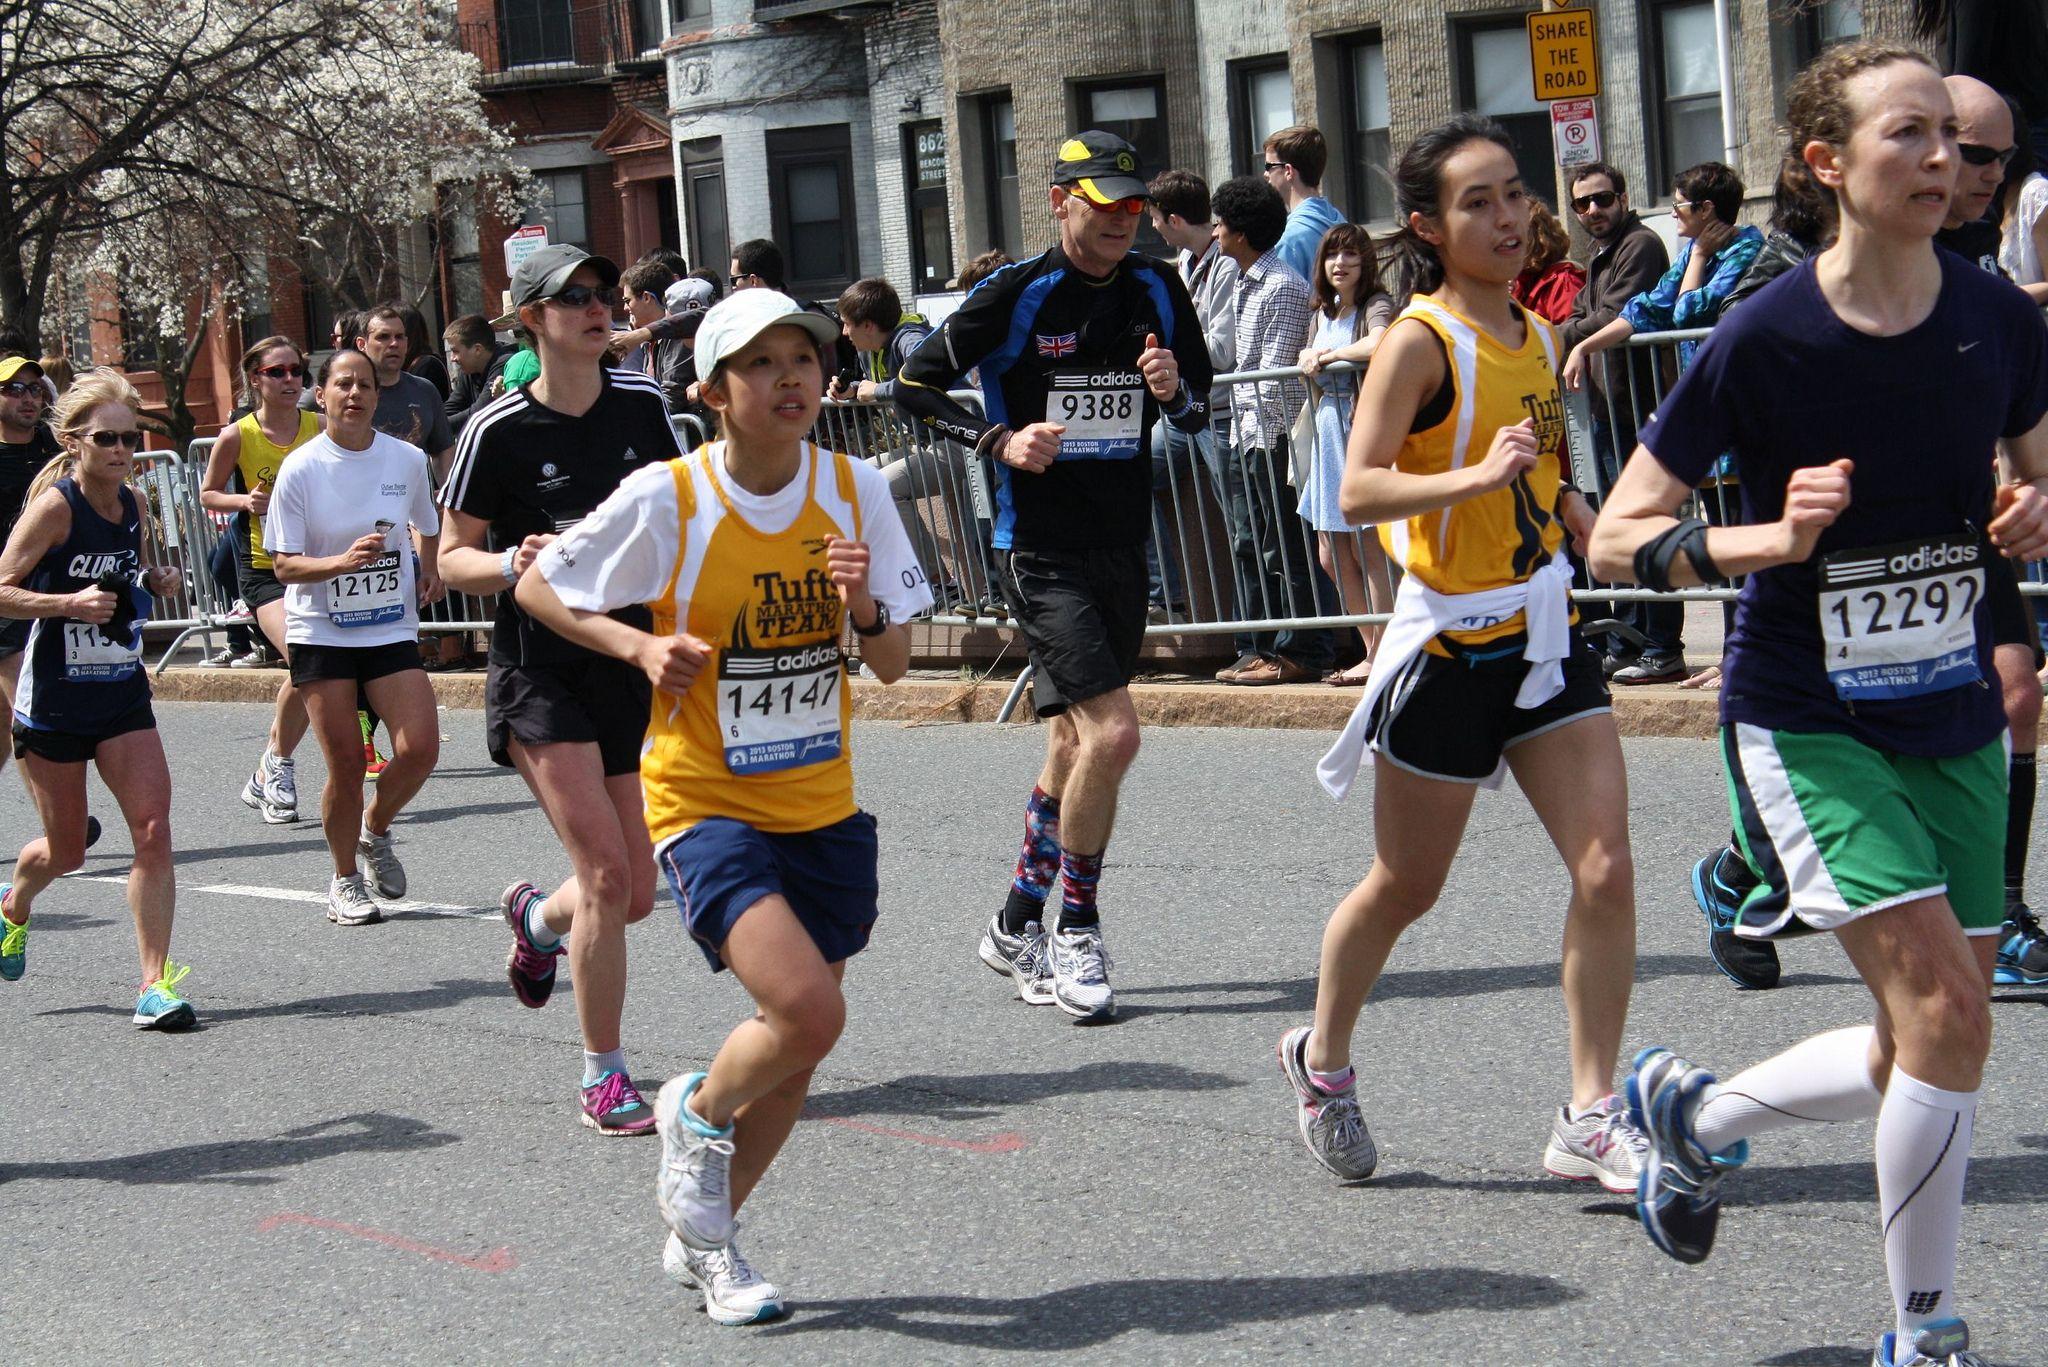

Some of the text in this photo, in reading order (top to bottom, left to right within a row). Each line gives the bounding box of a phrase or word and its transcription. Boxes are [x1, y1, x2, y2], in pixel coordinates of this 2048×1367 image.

[1536, 21, 1587, 40] SHARE
[1549, 48, 1579, 66] THE
[1544, 70, 1587, 89] ROAD
[1553, 101, 1592, 112] TOW ZONE
[919, 132, 944, 153] 862
[1090, 371, 1142, 386] adidas
[1062, 392, 1132, 420] 9388
[1889, 543, 1979, 574] adidas
[331, 571, 399, 597] 12125
[753, 568, 841, 606] Tufts
[756, 600, 840, 619] MARATHO
[756, 613, 836, 639] TEAM
[72, 651, 78, 660] 3
[777, 645, 839, 672] adidas
[1838, 646, 1848, 660] 4
[1857, 666, 1918, 680] 2013 BOSTON
[1860, 674, 1919, 687] MARATHON
[728, 670, 839, 719] 14147
[730, 725, 739, 738] 6
[749, 743, 795, 755] 2013 BOSTON
[750, 751, 796, 763] MARATHON
